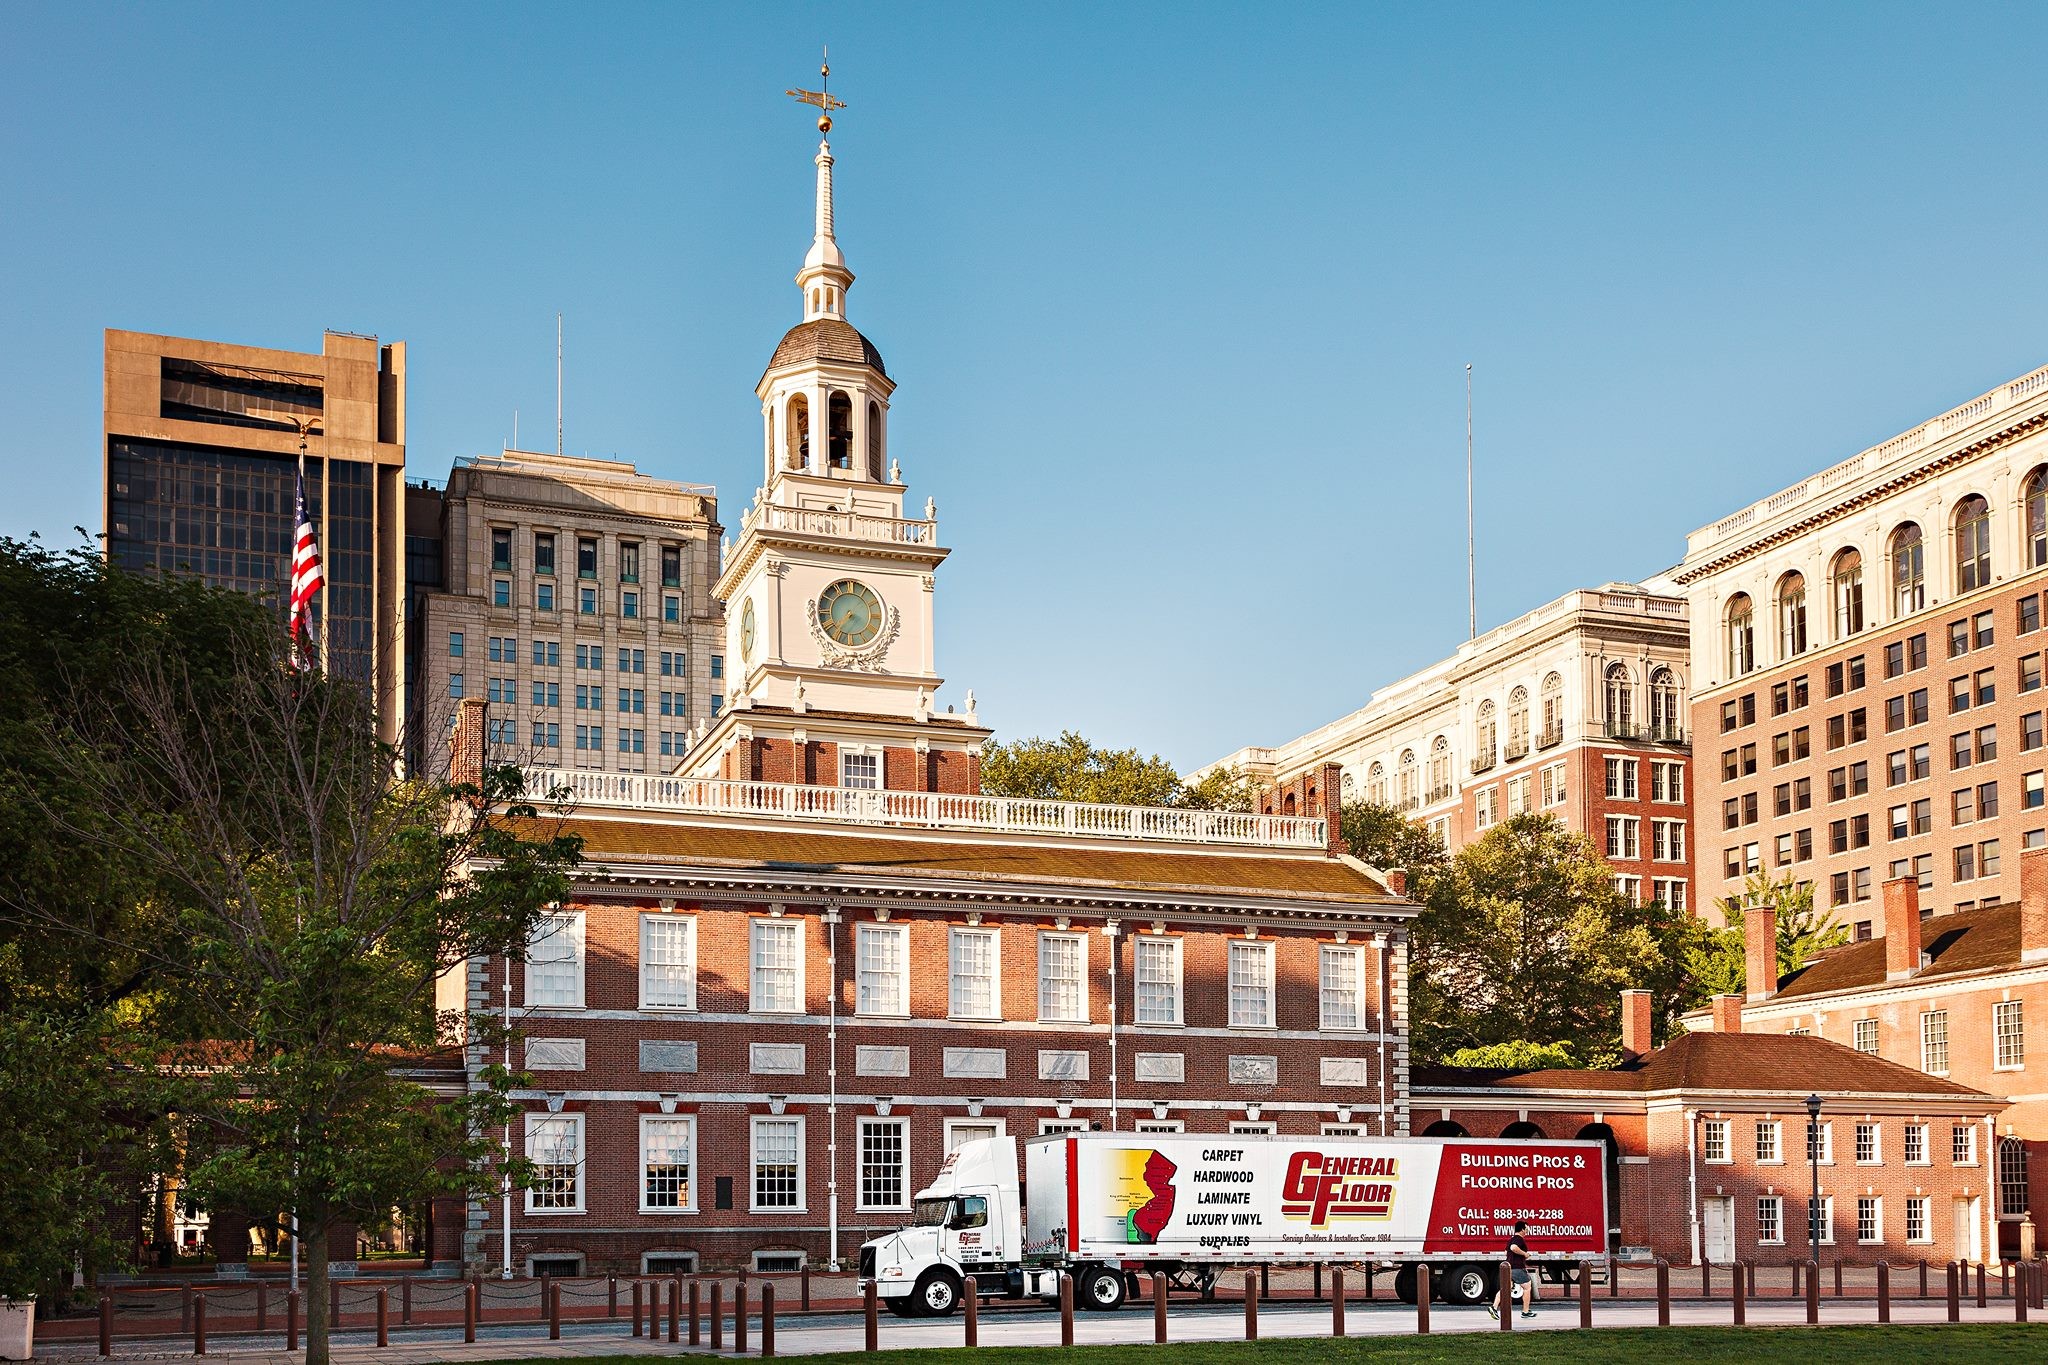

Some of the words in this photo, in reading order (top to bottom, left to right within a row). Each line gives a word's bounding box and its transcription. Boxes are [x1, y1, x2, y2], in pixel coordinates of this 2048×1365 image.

[1202, 1149, 1244, 1162] CARPET
[1460, 1153, 1529, 1168] BUILDING
[1532, 1154, 1570, 1169] PROS
[1573, 1155, 1585, 1169] &
[1193, 1170, 1254, 1183] HARDWOOD
[1282, 1151, 1396, 1202] GENERAL
[1461, 1174, 1533, 1189] FLOORING
[1536, 1175, 1575, 1190] PROS
[1198, 1192, 1250, 1204] LAMINATE
[1310, 1176, 1393, 1225] FLOOR
[1186, 1213, 1229, 1226] LUXURY
[1231, 1213, 1263, 1226] VINYL
[1458, 1206, 1490, 1220] CALL:
[1493, 1208, 1564, 1220] 888-304-2288
[1442, 1226, 1454, 1234] OR
[1458, 1223, 1490, 1236] VISIT:
[1199, 1236, 1250, 1247] SUPPLIES
[1282, 1234, 1303, 1244] Serving
[1304, 1234, 1327, 1242] Builders
[1328, 1234, 1333, 1242] &
[1334, 1234, 1359, 1242] Installers
[1360, 1234, 1376, 1242] Since
[1377, 1234, 1392, 1242] 1984
